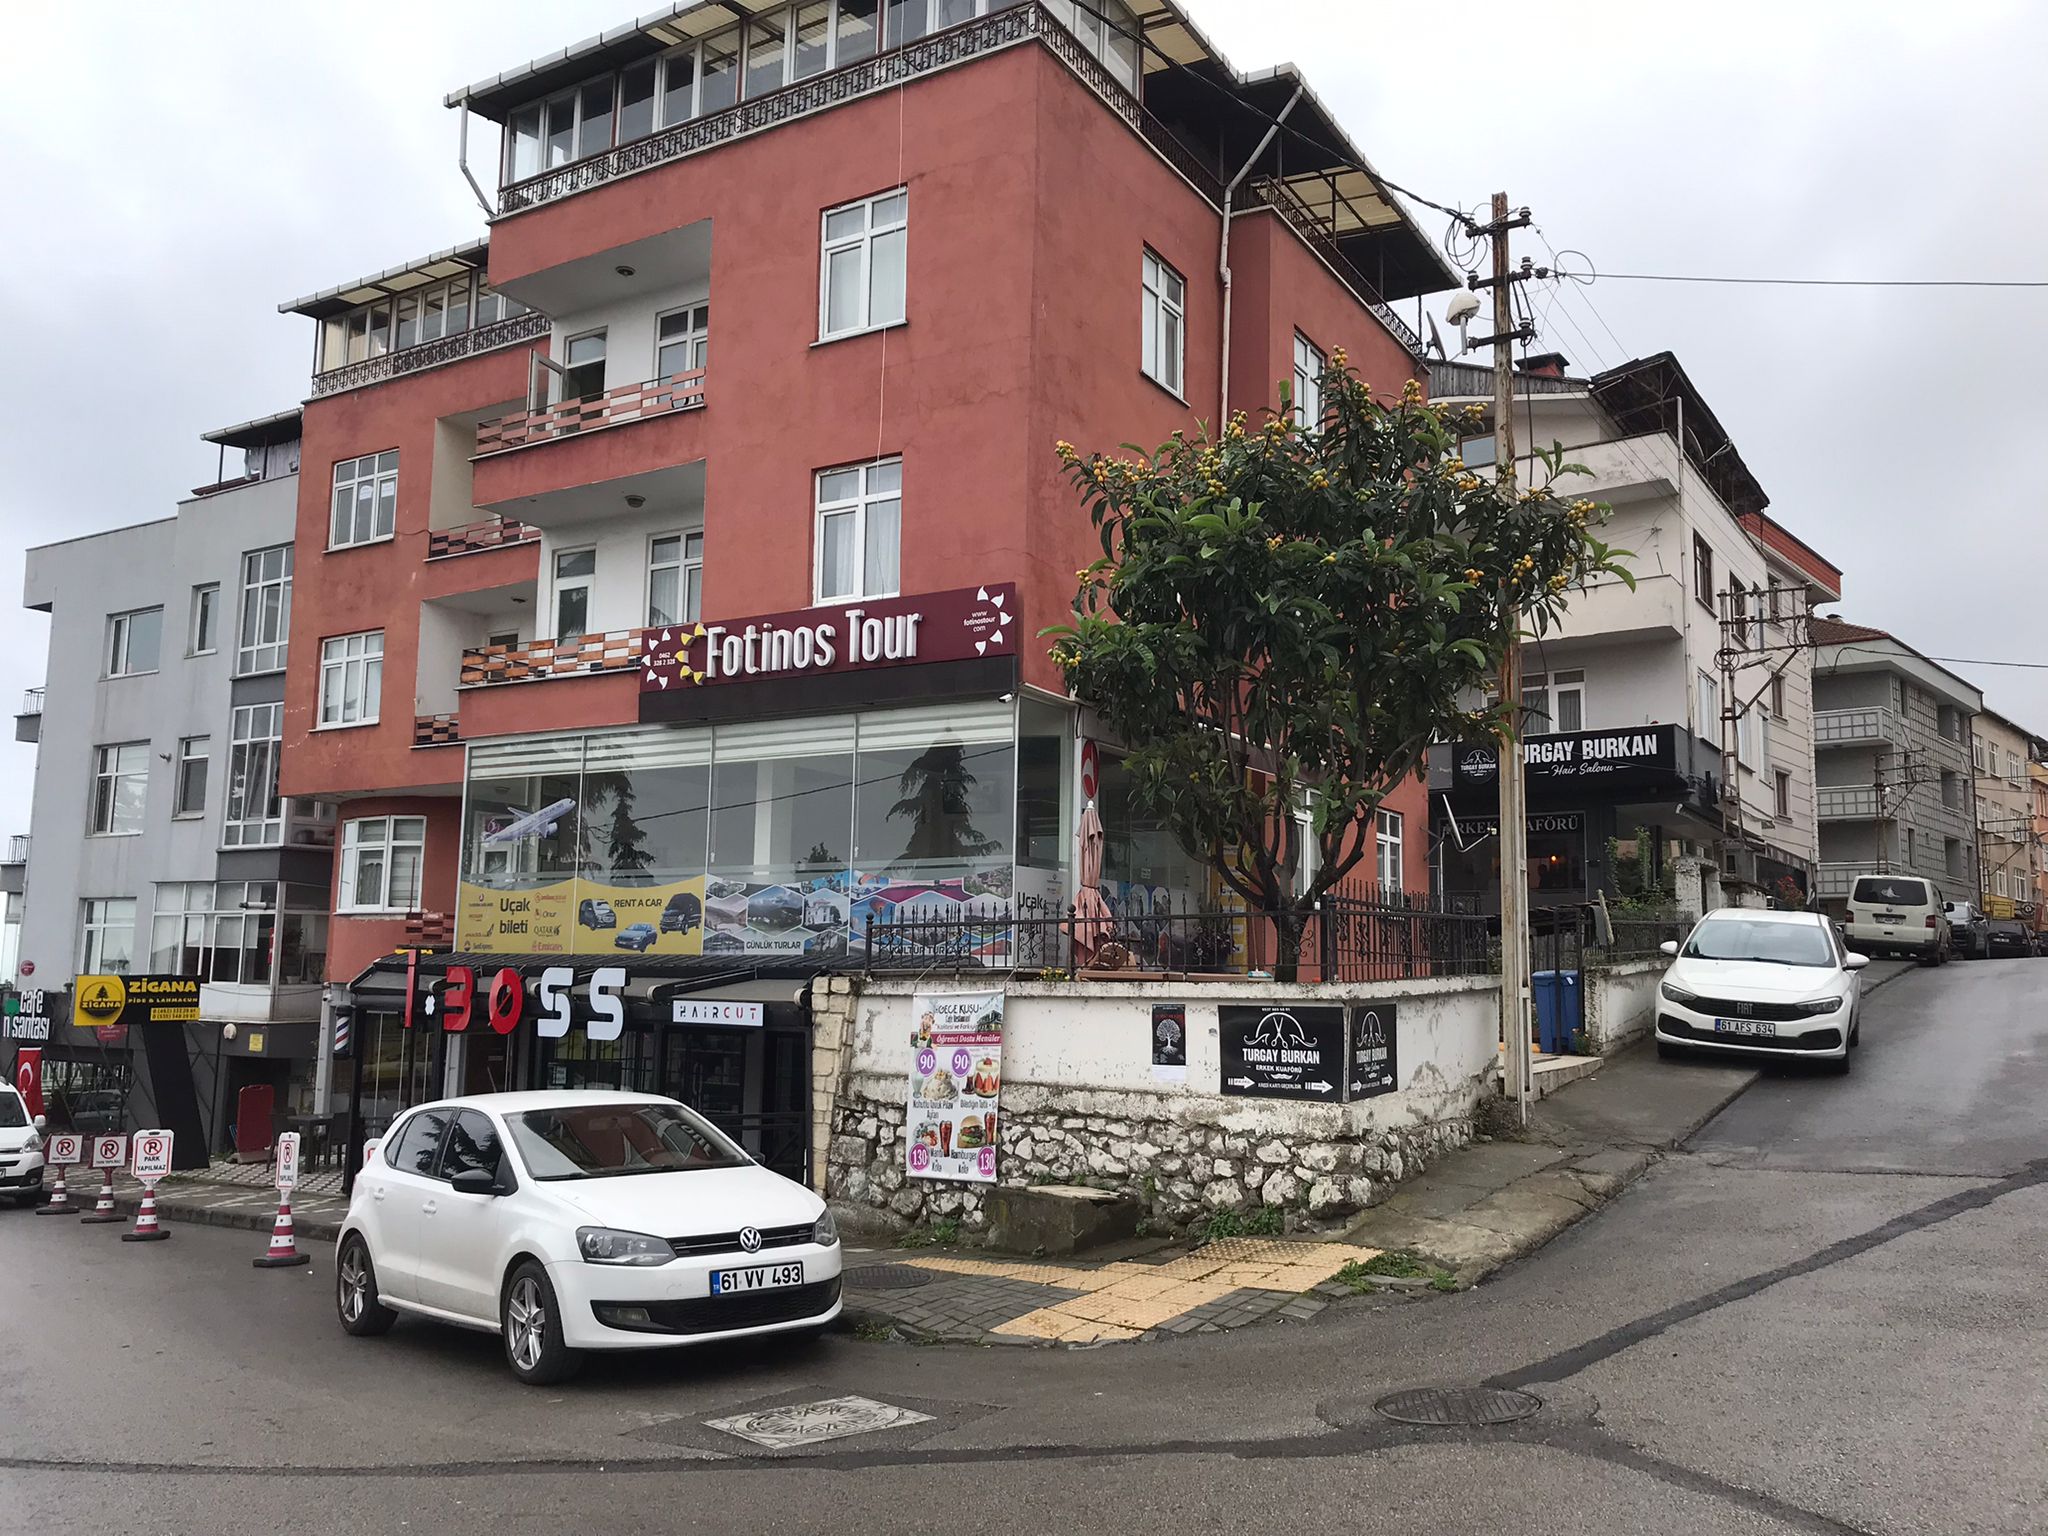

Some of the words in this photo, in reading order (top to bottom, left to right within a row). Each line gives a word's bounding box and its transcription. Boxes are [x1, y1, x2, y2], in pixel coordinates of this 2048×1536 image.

[963, 616, 996, 627] fotinostour
[972, 625, 987, 633] com
[706, 622, 836, 678] Fotinos
[845, 609, 922, 663] Tour
[1581, 733, 1658, 761] BURKAN
[1550, 764, 1577, 777] Hair
[1579, 761, 1614, 776] Salonu
[1526, 814, 1579, 832] AFÖRÜ
[500, 897, 531, 915] Uçak
[614, 898, 637, 908] RENT
[638, 899, 645, 907] A
[645, 898, 663, 907] CAR
[499, 920, 529, 934] bileti
[774, 940, 802, 950] TURLAR
[128, 977, 198, 993] ZİGANA
[1736, 1001, 1754, 1015] FIAT
[1721, 1020, 1731, 1031] 61
[1734, 1021, 1752, 1033] AFS
[1755, 1023, 1774, 1035] 634
[936, 1034, 959, 1045] Öğrenci
[959, 1034, 975, 1043] Dostu
[975, 1033, 1001, 1043] Menüler
[919, 1054, 934, 1070] 90
[954, 1054, 968, 1070] 90
[1242, 1048, 1279, 1063] TURGAY
[1280, 1049, 1320, 1064] BURKAN
[1275, 1065, 1303, 1074] KUAFÖRÜ
[912, 1148, 927, 1166] 130
[980, 1153, 994, 1171] 130
[137, 1164, 166, 1172] YAPILMAZ
[721, 1272, 738, 1290] 61
[744, 1269, 765, 1288] VV
[772, 1265, 801, 1285] 493
